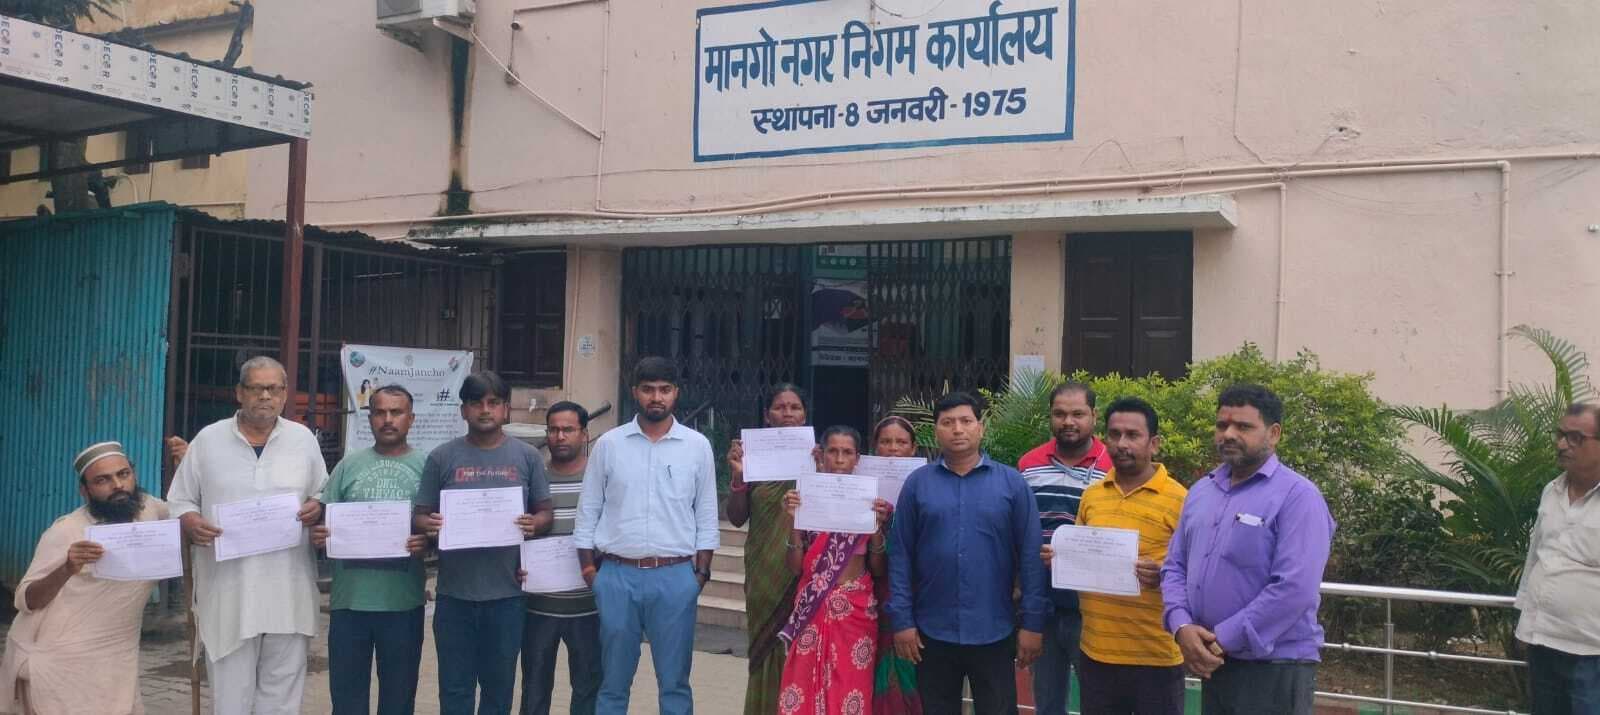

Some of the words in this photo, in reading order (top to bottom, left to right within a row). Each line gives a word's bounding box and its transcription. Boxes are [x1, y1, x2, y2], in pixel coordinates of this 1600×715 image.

[704, 27, 779, 92] मानगो
[781, 34, 837, 85] नगर
[842, 20, 920, 79] निगम
[926, 0, 1059, 72] कार्यालय
[866, 86, 948, 124] जनवरी
